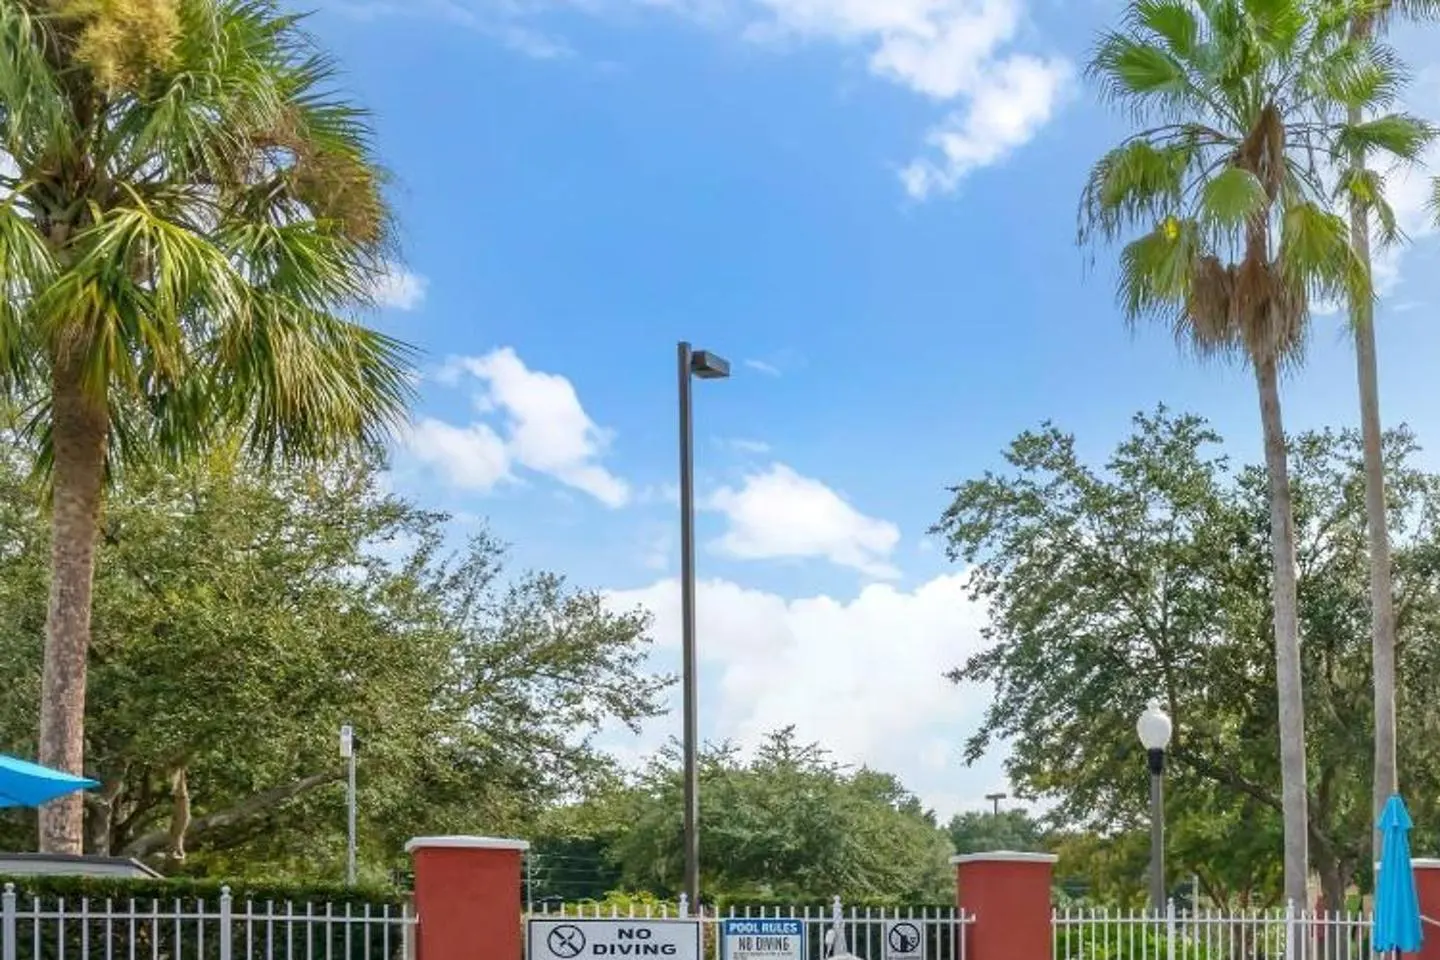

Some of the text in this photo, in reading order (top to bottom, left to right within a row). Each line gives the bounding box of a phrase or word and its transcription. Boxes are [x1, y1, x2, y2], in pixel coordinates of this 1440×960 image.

[618, 928, 652, 940] NO
[729, 922, 798, 934] POOL RULES
[592, 943, 677, 956] DIVING
[738, 936, 791, 951] NO DIVING
